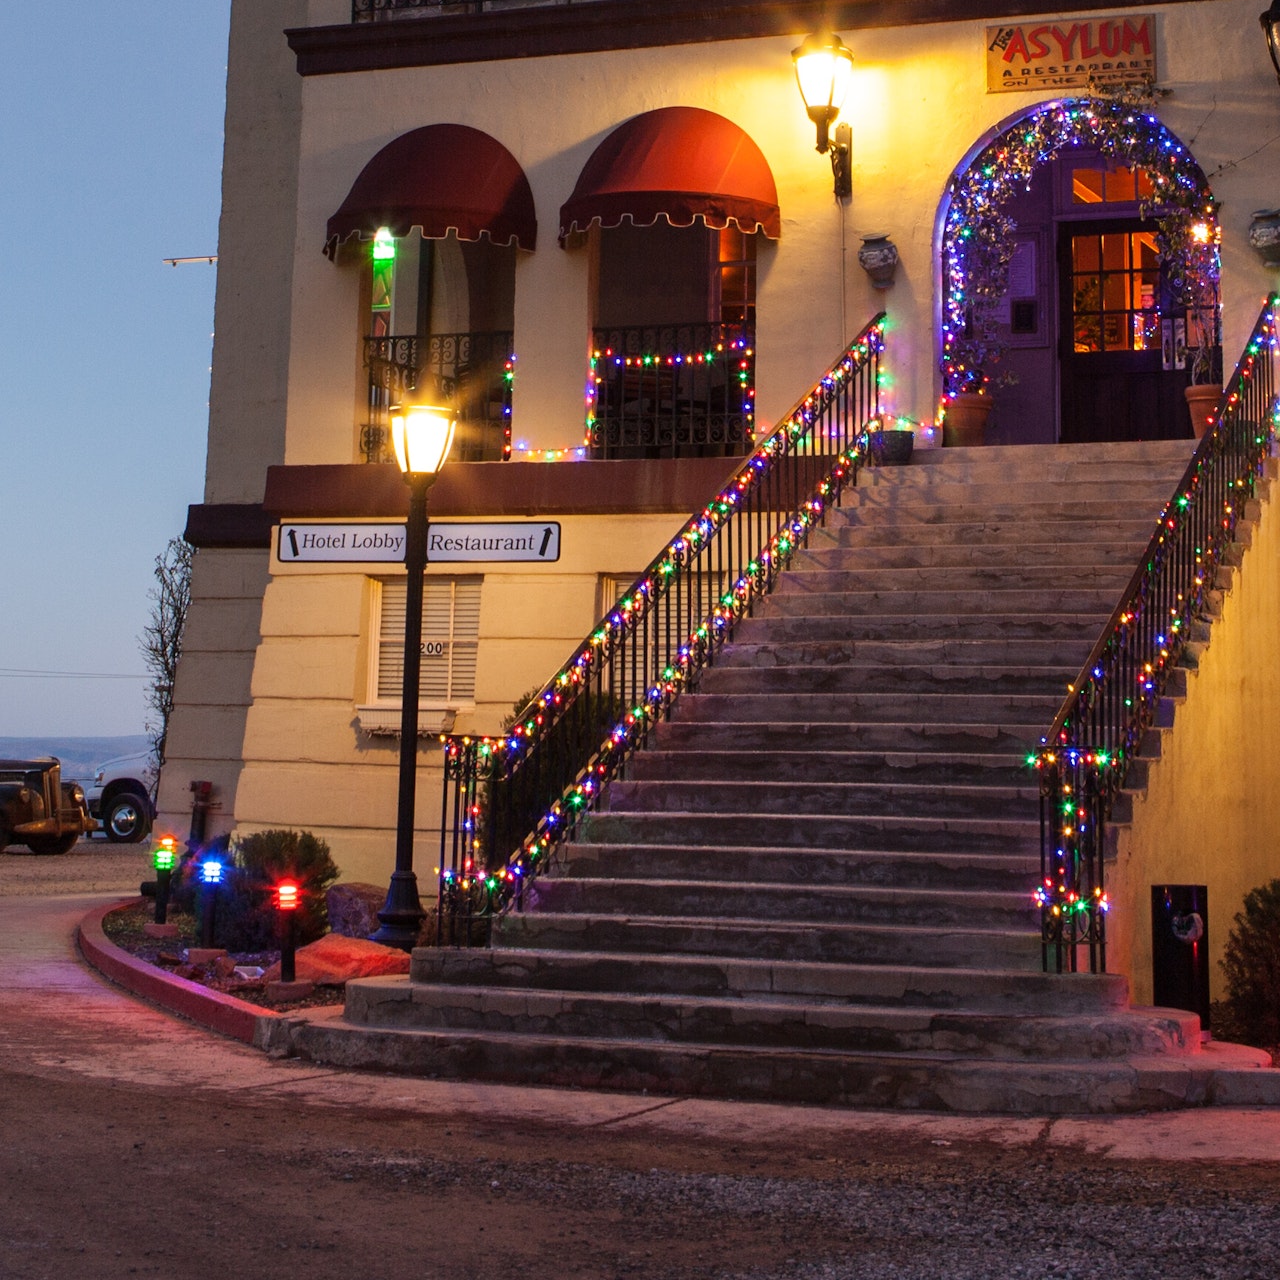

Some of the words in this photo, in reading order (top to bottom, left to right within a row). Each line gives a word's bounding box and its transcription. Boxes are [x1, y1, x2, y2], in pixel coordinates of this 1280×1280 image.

[1002, 18, 1153, 64] ASYLUM
[1002, 69, 1013, 78] A
[1002, 77, 1029, 88] ON
[1038, 76, 1078, 86] THE
[302, 533, 346, 549] Hotel
[351, 533, 405, 553] Lobby
[429, 533, 536, 551] Restaurant
